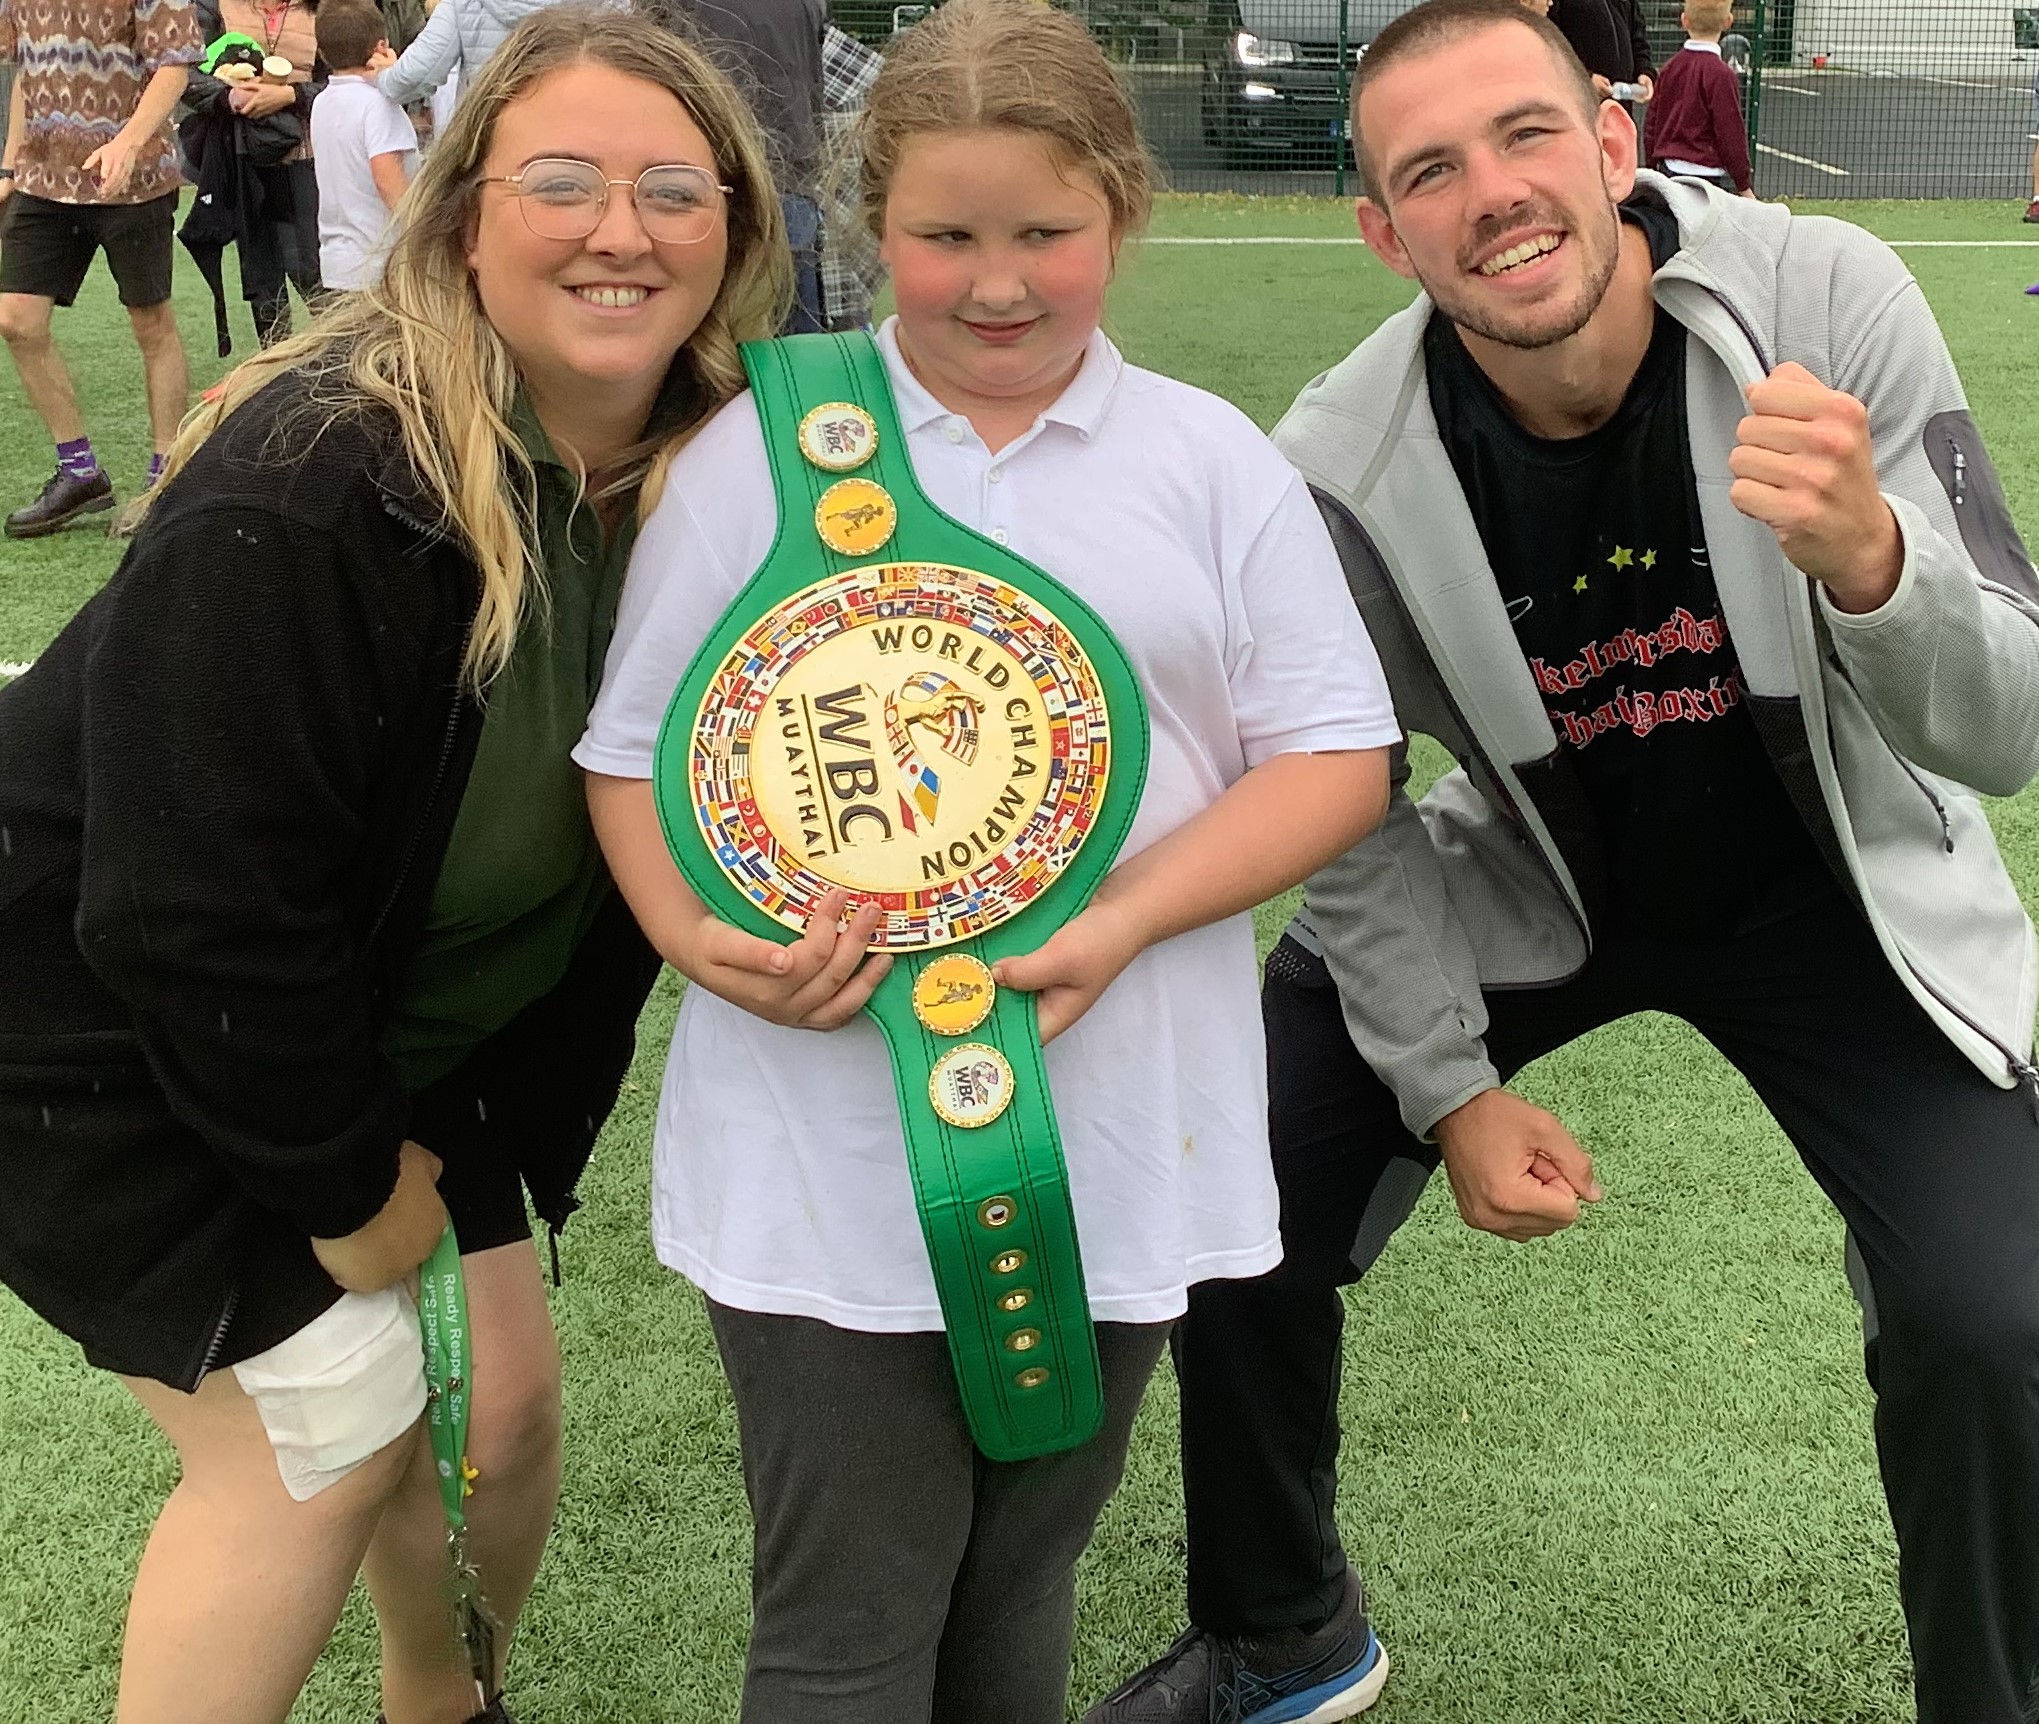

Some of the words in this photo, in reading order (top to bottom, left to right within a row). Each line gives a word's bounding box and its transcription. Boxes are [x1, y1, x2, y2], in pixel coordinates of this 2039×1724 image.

[824, 421, 844, 455] WBC
[871, 624, 1011, 691] WORLD
[776, 697, 828, 860] MUAYTHAI
[814, 682, 894, 846] WBC
[920, 697, 1038, 881] CHAMPION
[956, 1066, 976, 1108] WBC
[443, 1273, 459, 1323] Ready
[450, 1328, 462, 1382] Respe
[450, 1394, 463, 1425] Safe
